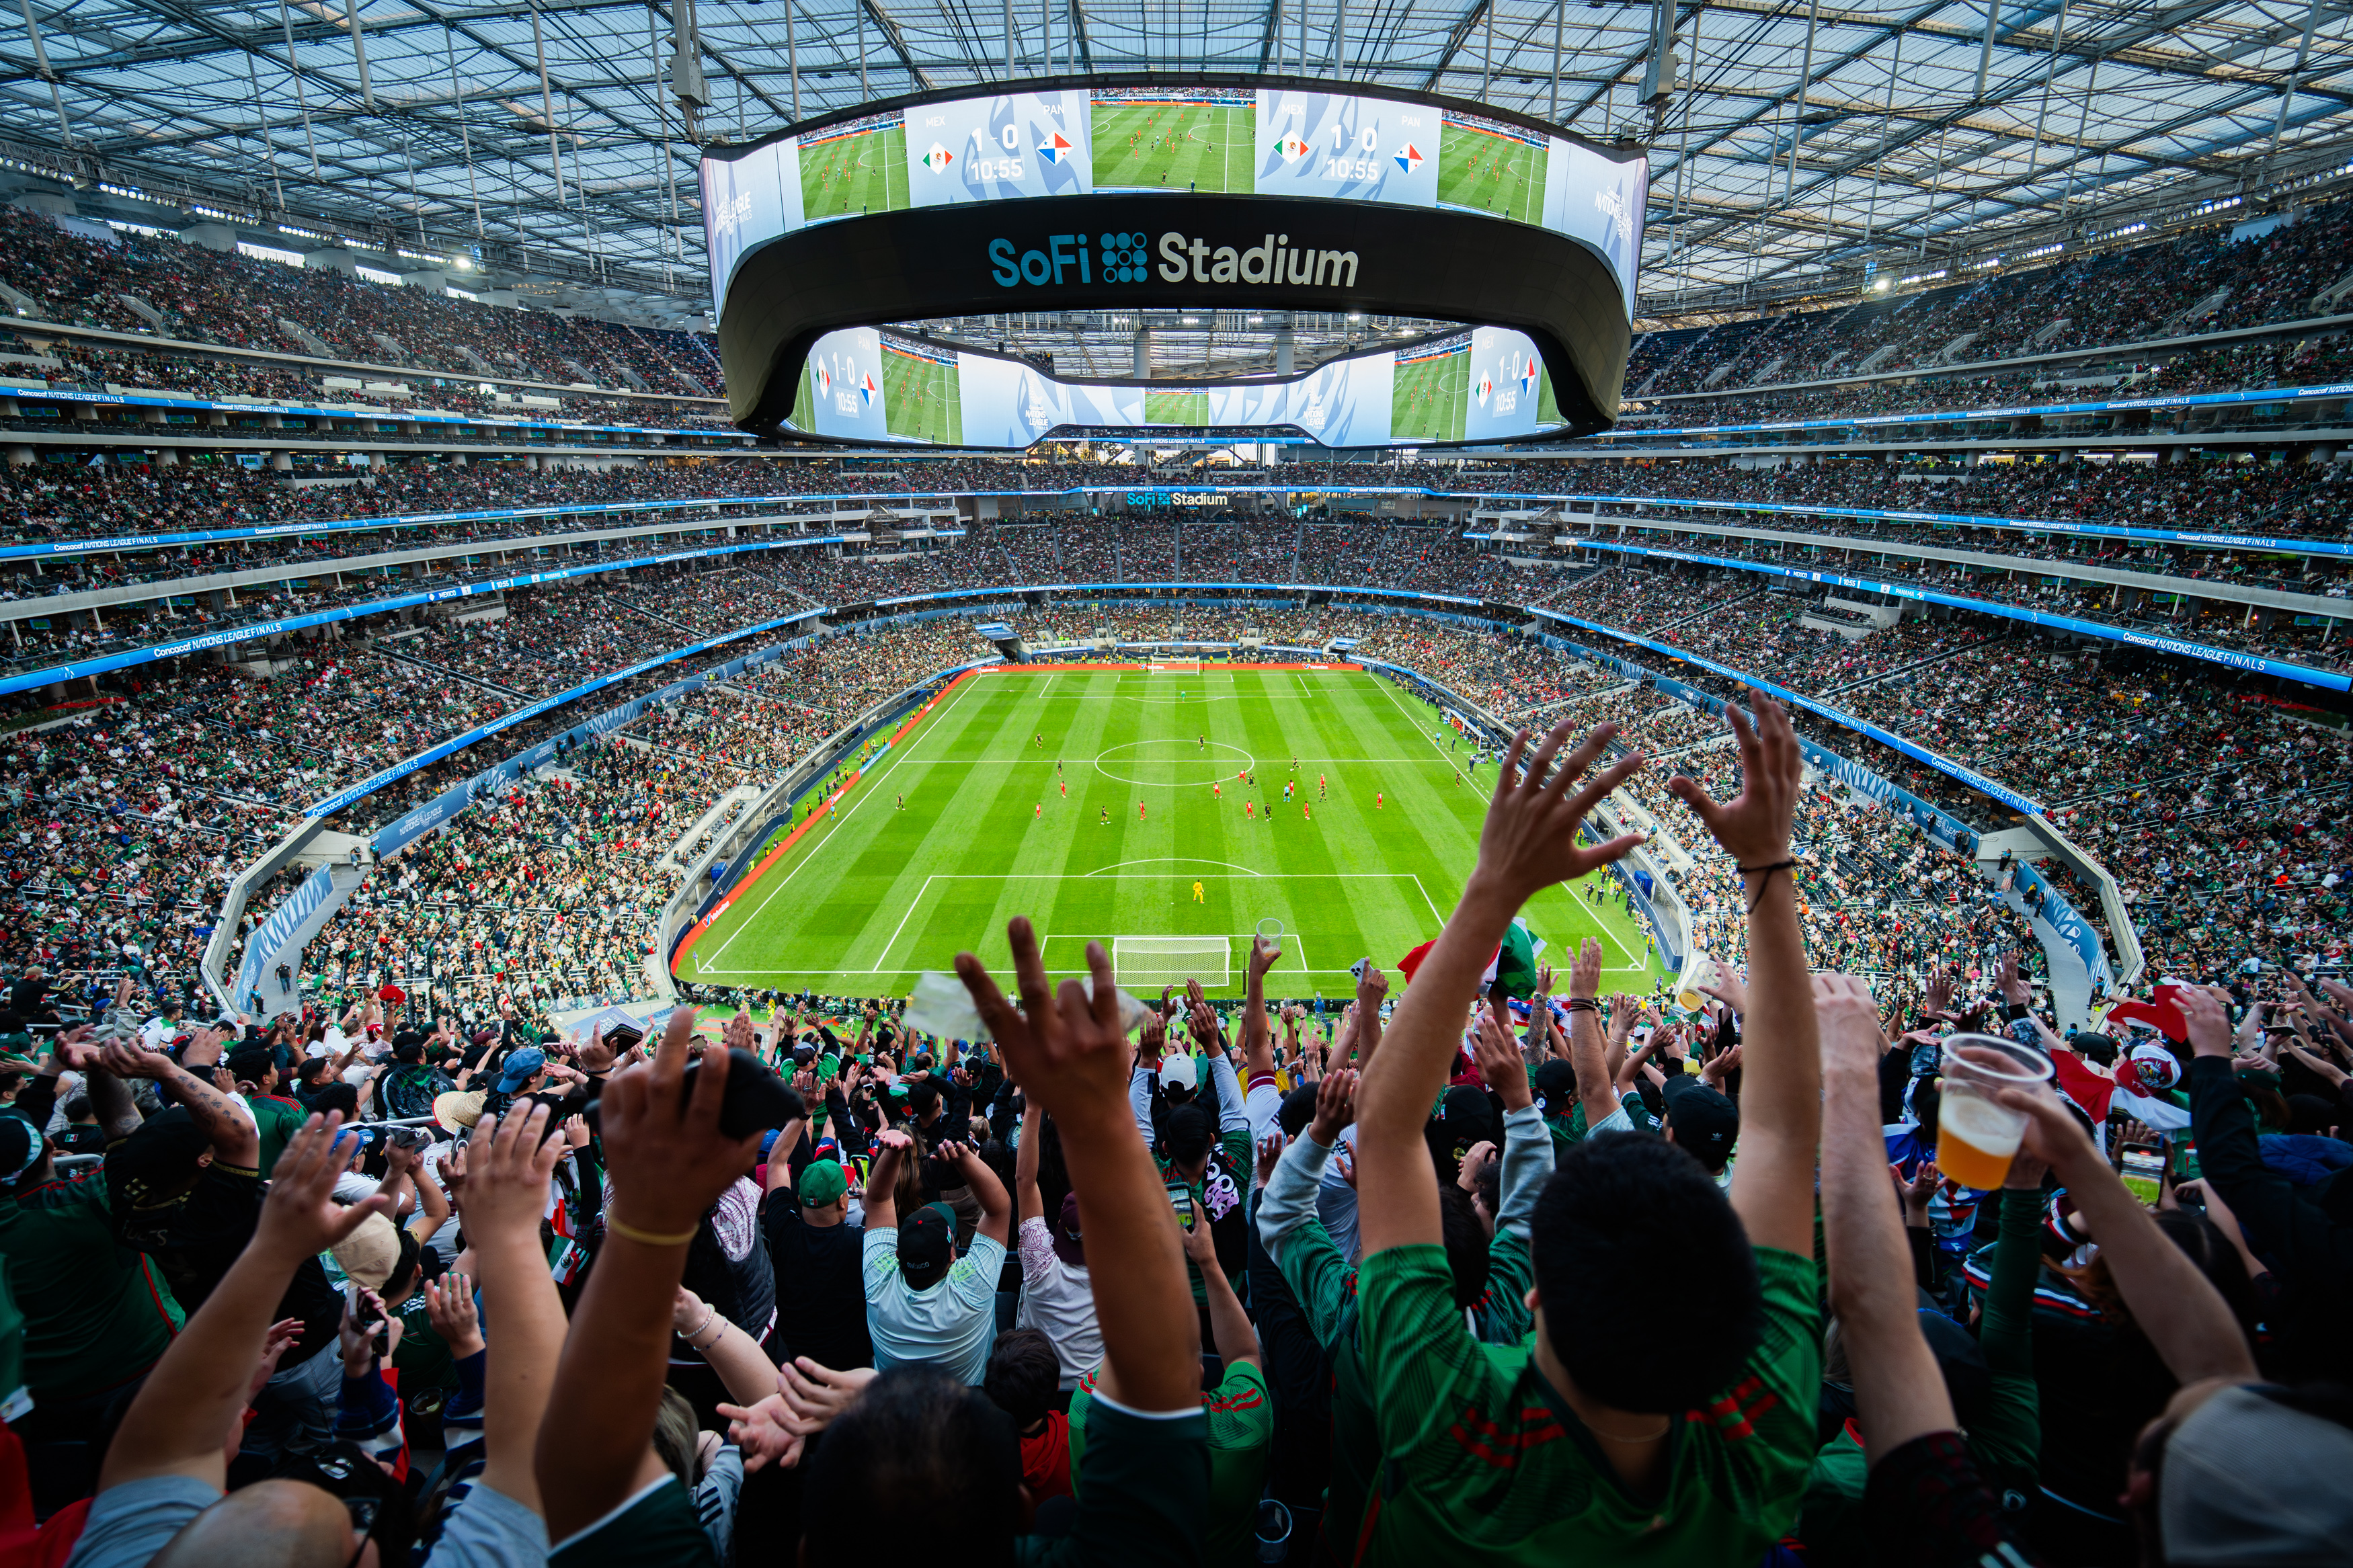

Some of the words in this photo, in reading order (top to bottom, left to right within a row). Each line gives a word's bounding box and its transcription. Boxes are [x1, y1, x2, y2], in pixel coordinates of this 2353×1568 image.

[1043, 103, 1065, 116] PAN
[1282, 104, 1304, 116] MEX
[926, 115, 946, 128] MEX
[1402, 115, 1421, 128] PAN
[971, 127, 983, 151] 1
[1002, 123, 1019, 150] 0
[1332, 124, 1342, 149] 1
[1361, 128, 1377, 153] 0
[969, 158, 1023, 181] 10:55
[1327, 158, 1379, 181] 10:55
[1595, 190, 1619, 220] NATIONS
[735, 209, 752, 225] FINALS
[988, 233, 1092, 288] SoFi
[1158, 232, 1359, 288] Stadium
[858, 335, 871, 350] PAN
[1481, 334, 1494, 350] MEX
[832, 352, 839, 381] 1
[846, 356, 855, 385] 0
[1499, 356, 1505, 384] 1
[1512, 350, 1519, 380] 0
[836, 391, 857, 413] 10:55
[1496, 390, 1516, 412] 10:55
[1025, 410, 1046, 419] NATIONS
[1029, 418, 1048, 426] LEAGUE
[1303, 410, 1324, 419] NATIONS
[1307, 417, 1326, 427] LEAGUE
[1127, 492, 1155, 505] SoFi
[1172, 492, 1228, 505] Stadium
[54, 542, 83, 550] Concacaf
[2247, 538, 2276, 546] FINALS
[438, 590, 456, 598] MEXICO
[1895, 588, 1915, 597] PANAMA
[153, 642, 190, 657] Concacaf
[192, 634, 223, 649] NATIONS
[224, 629, 250, 642] LEAGUE
[250, 622, 281, 636] FINALS
[2123, 632, 2158, 646] Concacaf
[2158, 639, 2191, 653] NATIONS
[2191, 647, 2223, 661] LEAGUE
[2223, 653, 2265, 669] FINALS
[622, 666, 637, 675] NATIONS
[636, 661, 651, 671] LEAGUE
[649, 656, 664, 665] FINALS
[1702, 661, 1716, 669] NATIONS
[1716, 665, 1729, 674] LEAGUE
[1729, 669, 1745, 680] FINALS
[506, 711, 523, 725] NATIONS
[524, 704, 539, 716] LEAGUE
[538, 697, 558, 709] FINALS
[1811, 703, 1829, 715] NATIONS
[1829, 710, 1845, 722] LEAGUE
[1845, 717, 1866, 731] FINALS
[313, 795, 343, 817] Concacaf
[345, 782, 369, 802] NATIONS
[370, 771, 392, 788] LEAGUE
[391, 759, 417, 777] FINALS
[1931, 757, 1958, 774] Concacaf
[1958, 769, 1982, 786] NATIONS
[1981, 780, 2006, 799] LEAGUE
[2005, 792, 2036, 815] FINALS
[424, 805, 443, 821] LEAGUE
[399, 819, 420, 836] NATIONS
[143, 1026, 152, 1034] 7
